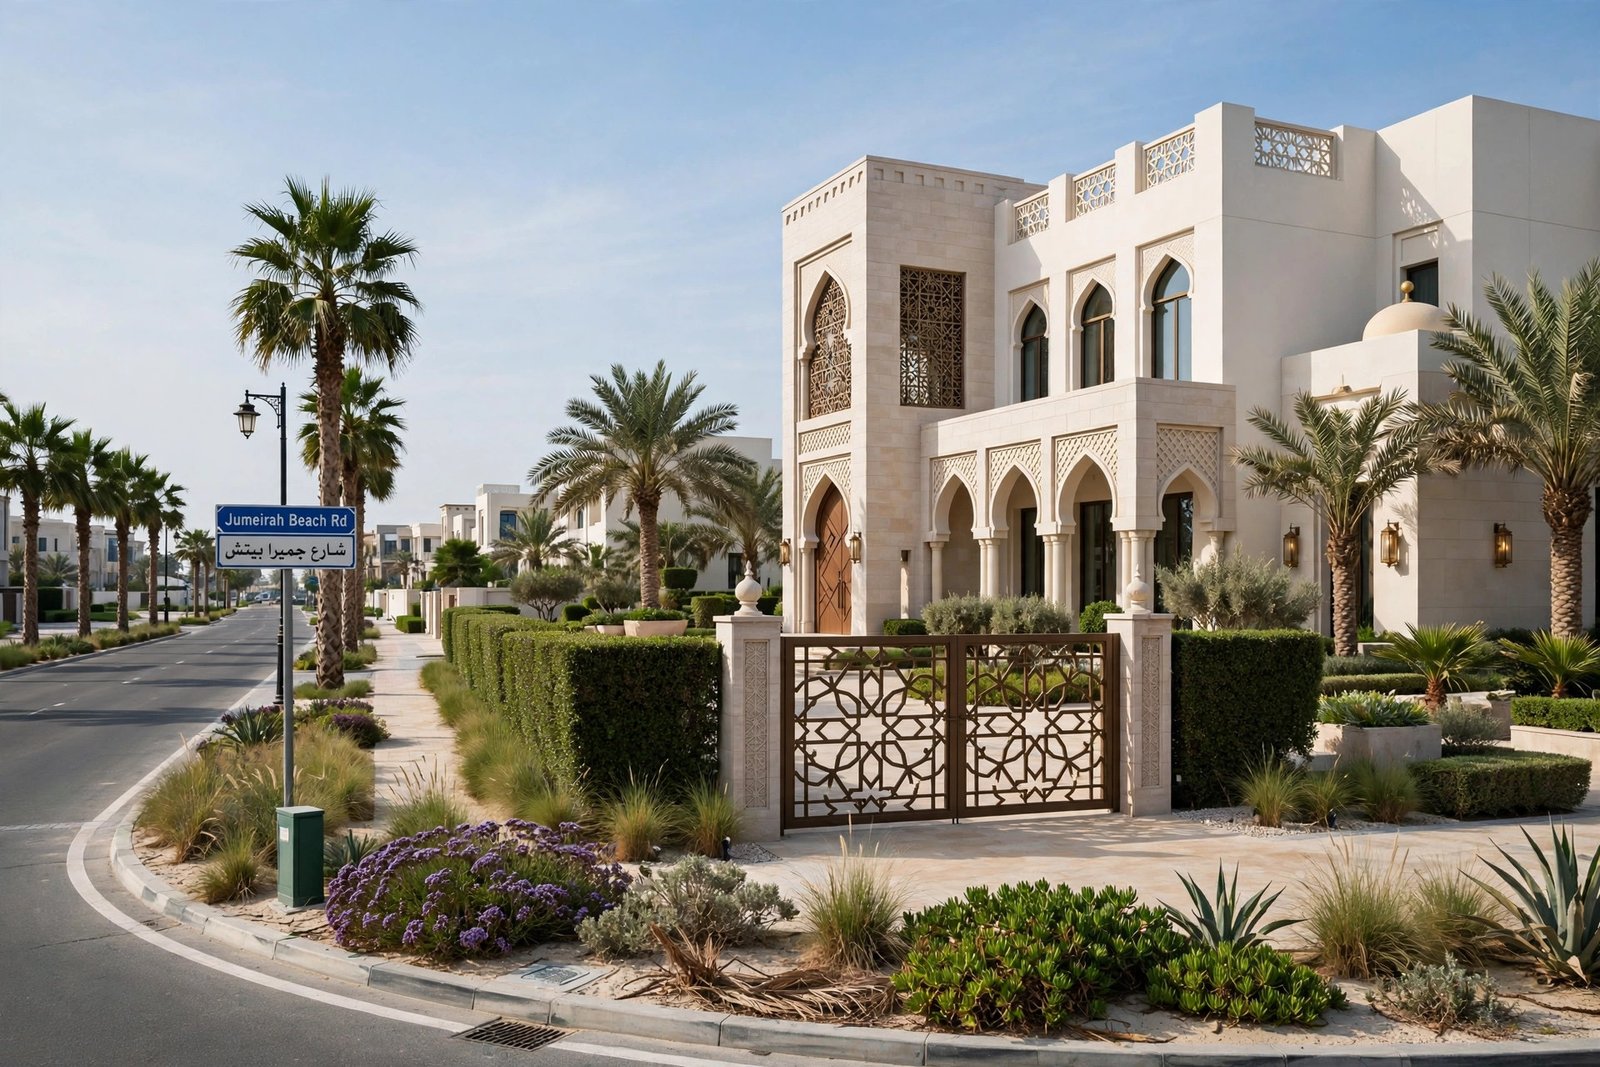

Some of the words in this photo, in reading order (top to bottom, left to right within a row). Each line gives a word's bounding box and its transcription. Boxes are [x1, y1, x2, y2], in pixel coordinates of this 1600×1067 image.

[225, 513, 284, 527] Jumeirah
[289, 513, 326, 527] Beach
[331, 514, 347, 527] Rd
[225, 542, 263, 560] بيتش
[268, 543, 306, 560] جميرا
[311, 543, 346, 562] شارع
